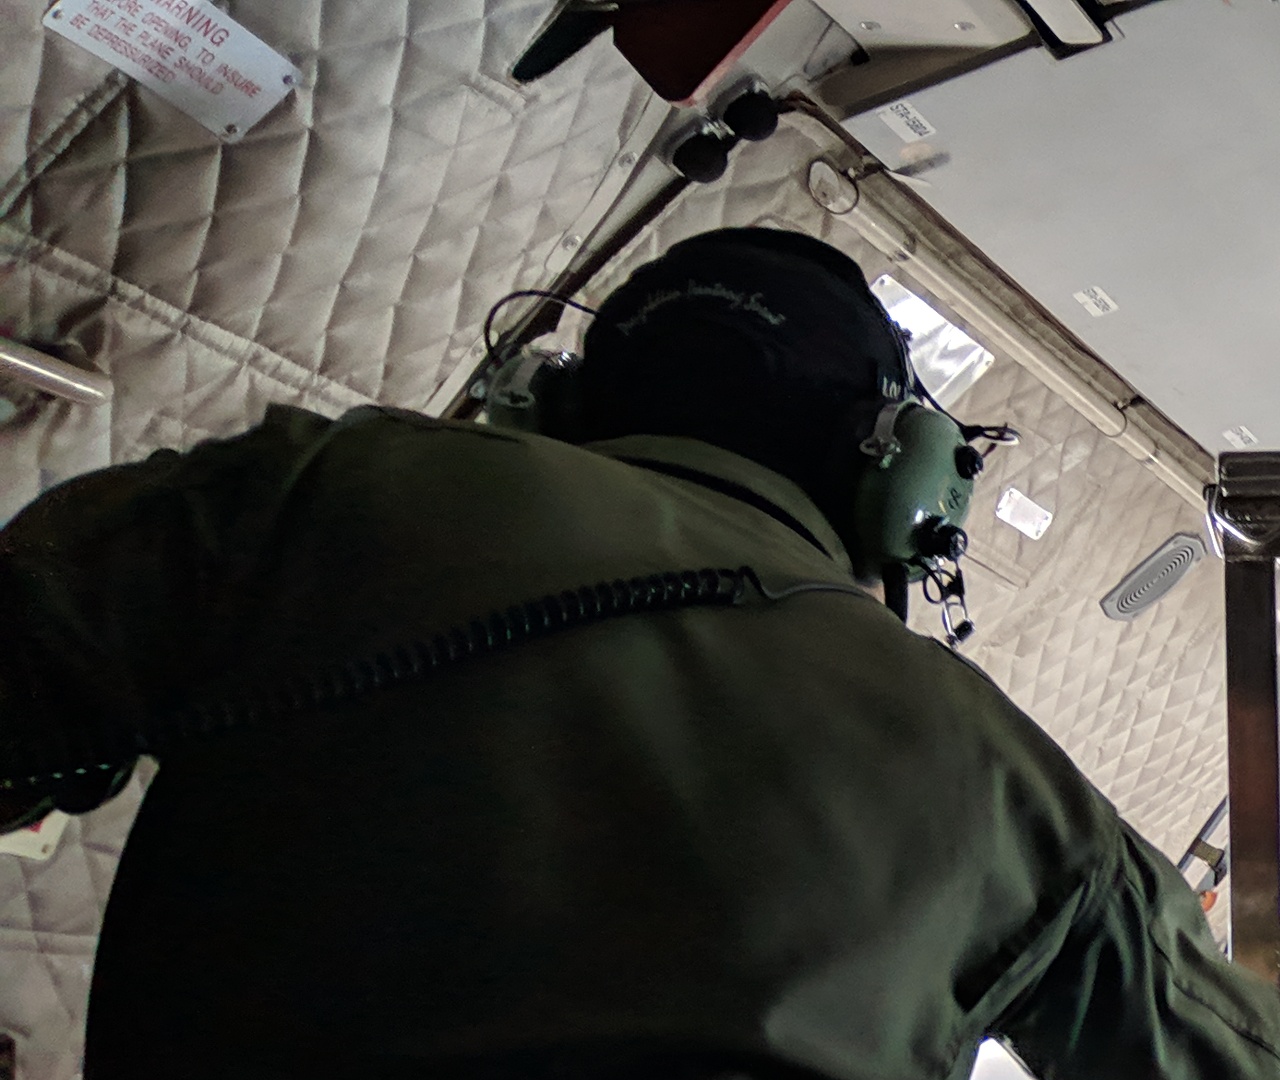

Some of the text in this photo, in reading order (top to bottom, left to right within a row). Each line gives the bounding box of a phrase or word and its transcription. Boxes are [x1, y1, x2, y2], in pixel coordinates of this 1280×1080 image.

[69, 13, 177, 84] BE DEPRESSURIZED
[115, 16, 137, 36] THE
[137, 30, 175, 60] PLANE
[174, 56, 224, 95] SHOULD
[197, 47, 215, 65] TO
[216, 62, 262, 97] INSURE
